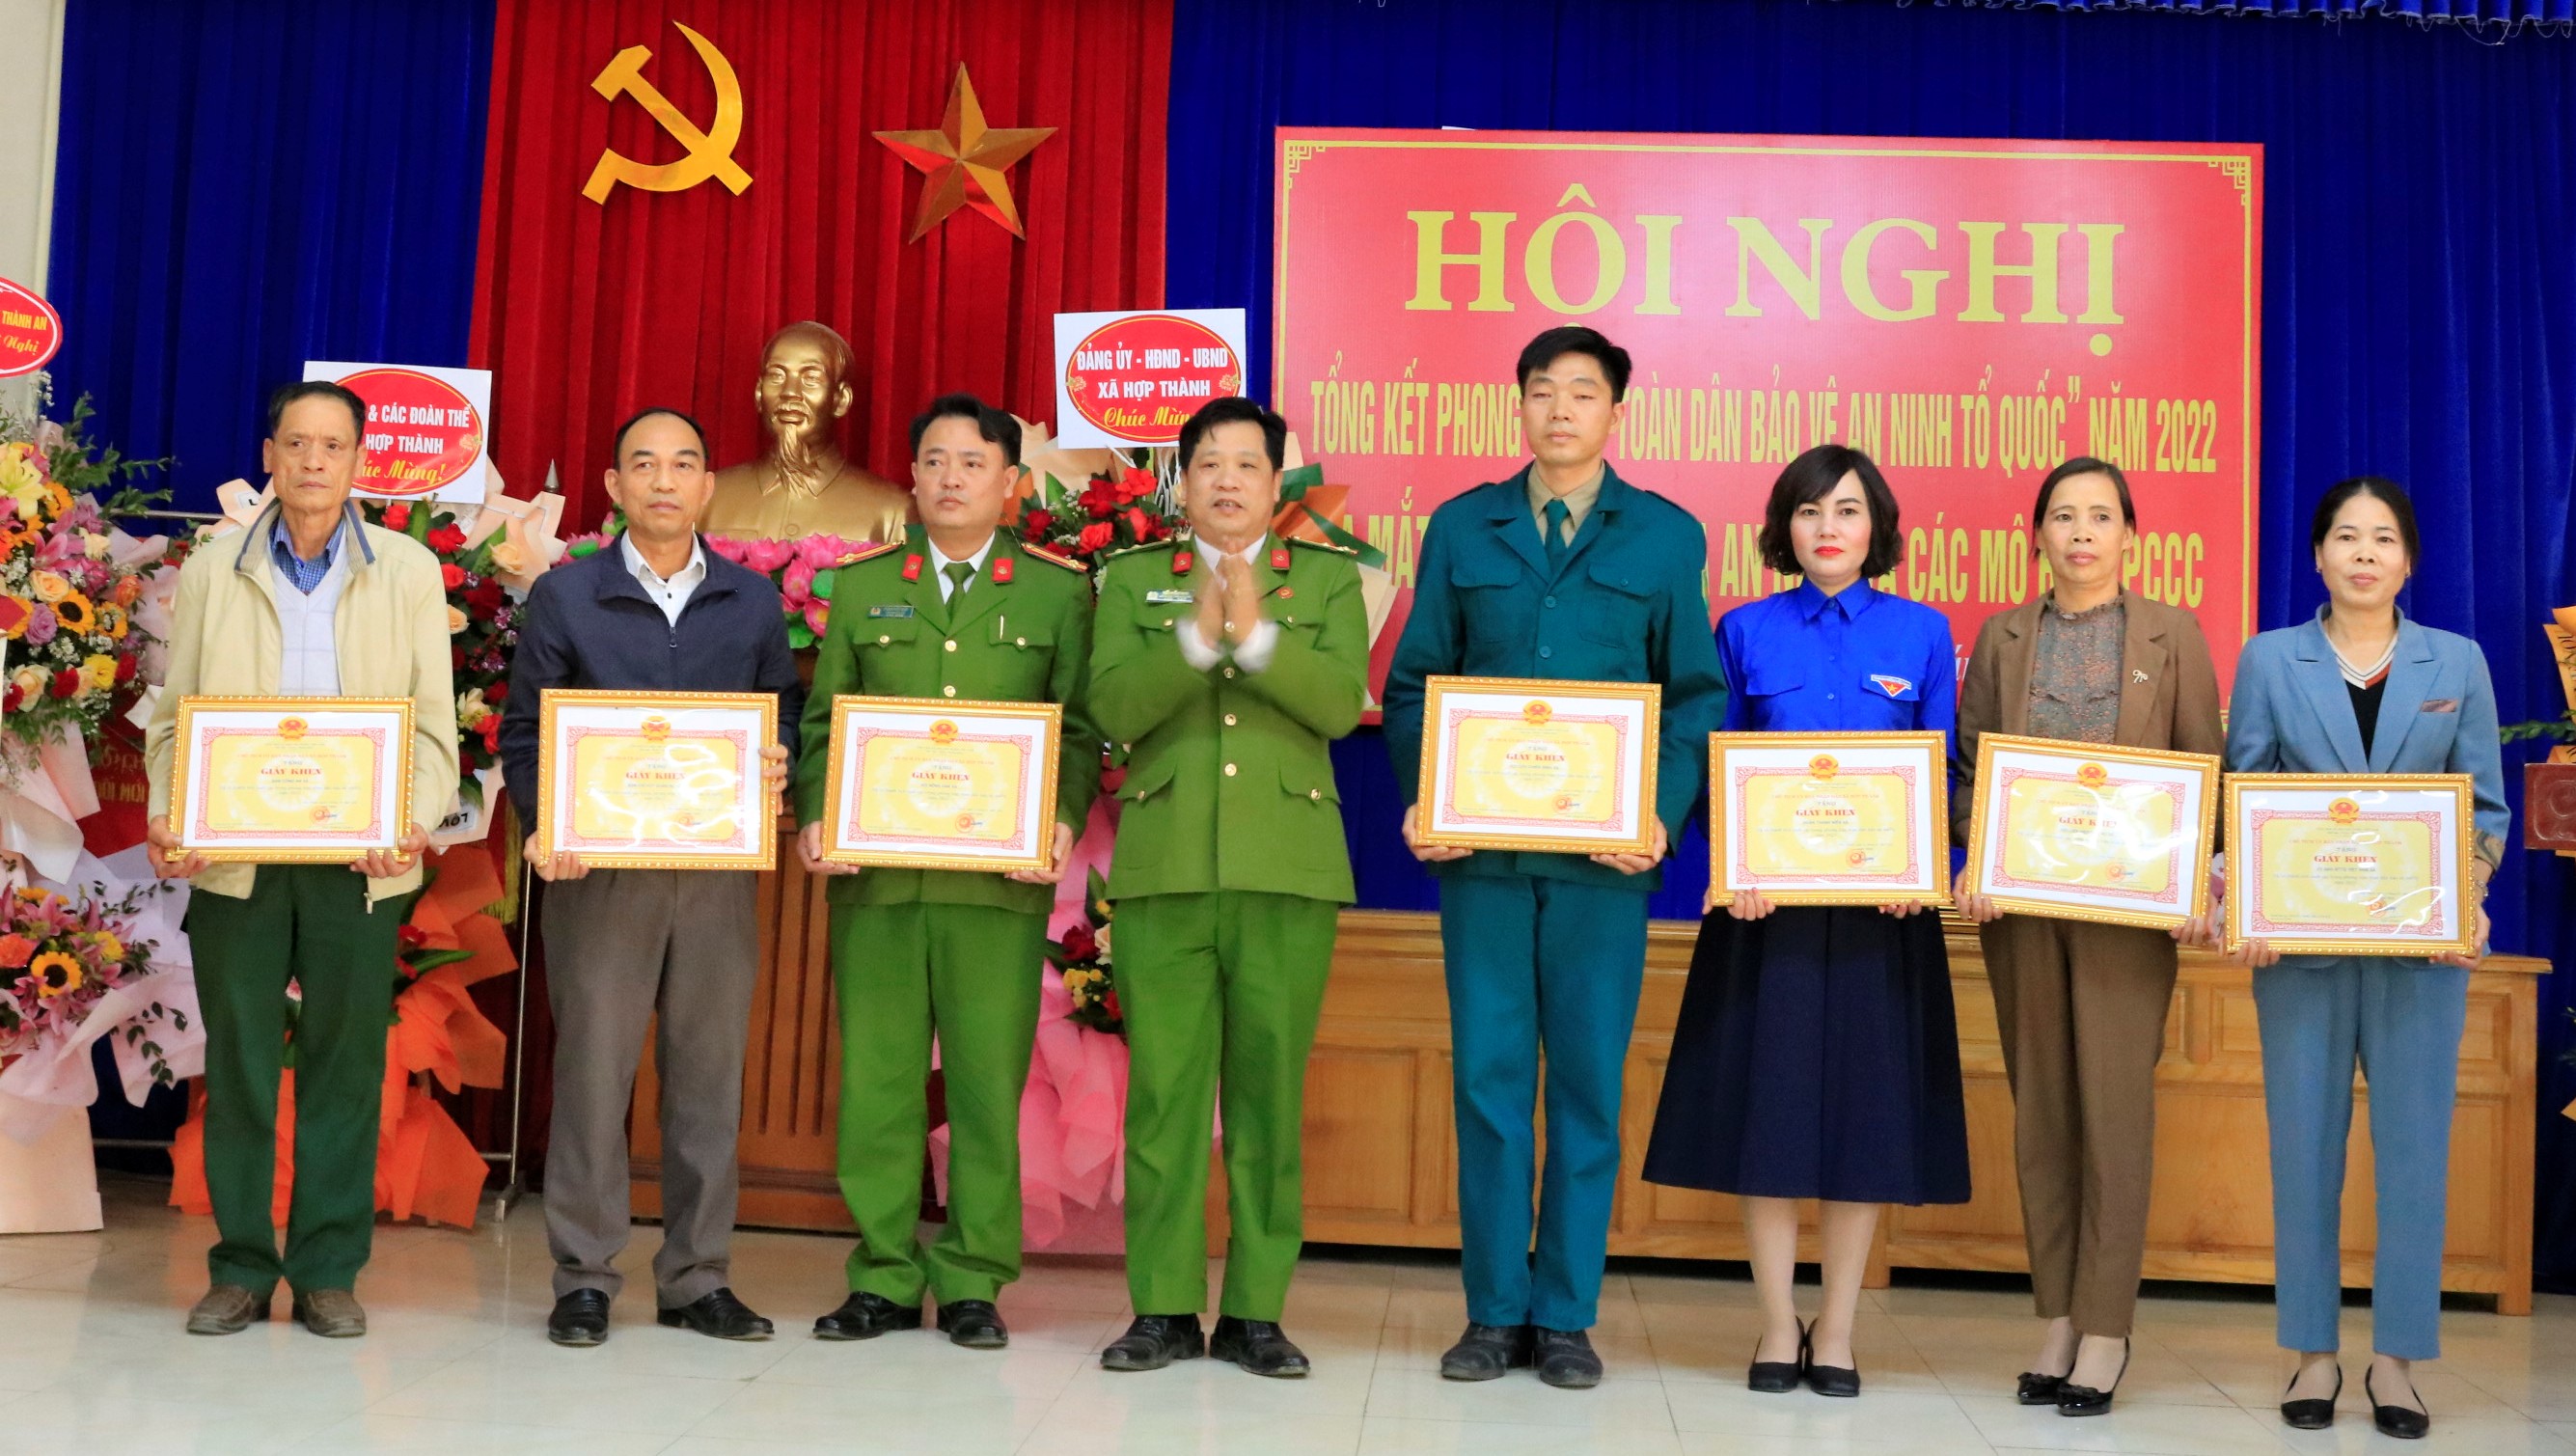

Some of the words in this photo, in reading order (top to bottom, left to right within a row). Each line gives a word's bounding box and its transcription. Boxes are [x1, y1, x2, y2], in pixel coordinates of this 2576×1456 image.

[1405, 183, 1683, 327] HỘI
[1725, 216, 2124, 357] NGHỊ
[2, 310, 33, 329] THÀNH
[33, 316, 48, 331] AN
[3, 335, 40, 356] Nghị
[1077, 343, 1112, 371] ĐẢNG
[1116, 342, 1133, 370] ỦY
[1144, 349, 1181, 369] HĐND
[1192, 347, 1228, 368] UBND
[1098, 379, 1119, 398] XÃ
[1123, 379, 1155, 401] HỢP
[1159, 377, 1211, 397] THÀNH
[368, 404, 377, 423] &
[381, 401, 407, 425] CÁC
[409, 404, 445, 426] ĐOÀN
[447, 403, 471, 428] THỂ
[1104, 407, 1146, 427] Chúc
[1149, 406, 1190, 426] Mừn
[1310, 349, 1376, 455] TỔNG
[1383, 357, 1430, 456] KẾT
[1436, 382, 1521, 458] PHONG
[1689, 372, 1742, 463] DÂN
[1749, 364, 1800, 464] BẢO
[1847, 392, 1882, 466] AN
[1890, 393, 1953, 468] NINH
[1959, 364, 1991, 470] TỔ
[2089, 380, 2148, 472] NĂM
[2155, 398, 2217, 474] 2022
[365, 433, 395, 455] HỢP
[397, 433, 444, 454] THÀNH
[362, 460, 381, 479] úc
[384, 459, 447, 485] Mừng!
[1719, 523, 1764, 597] AN
[1908, 511, 1969, 604] CÁC
[1979, 513, 2027, 605] MÔ
